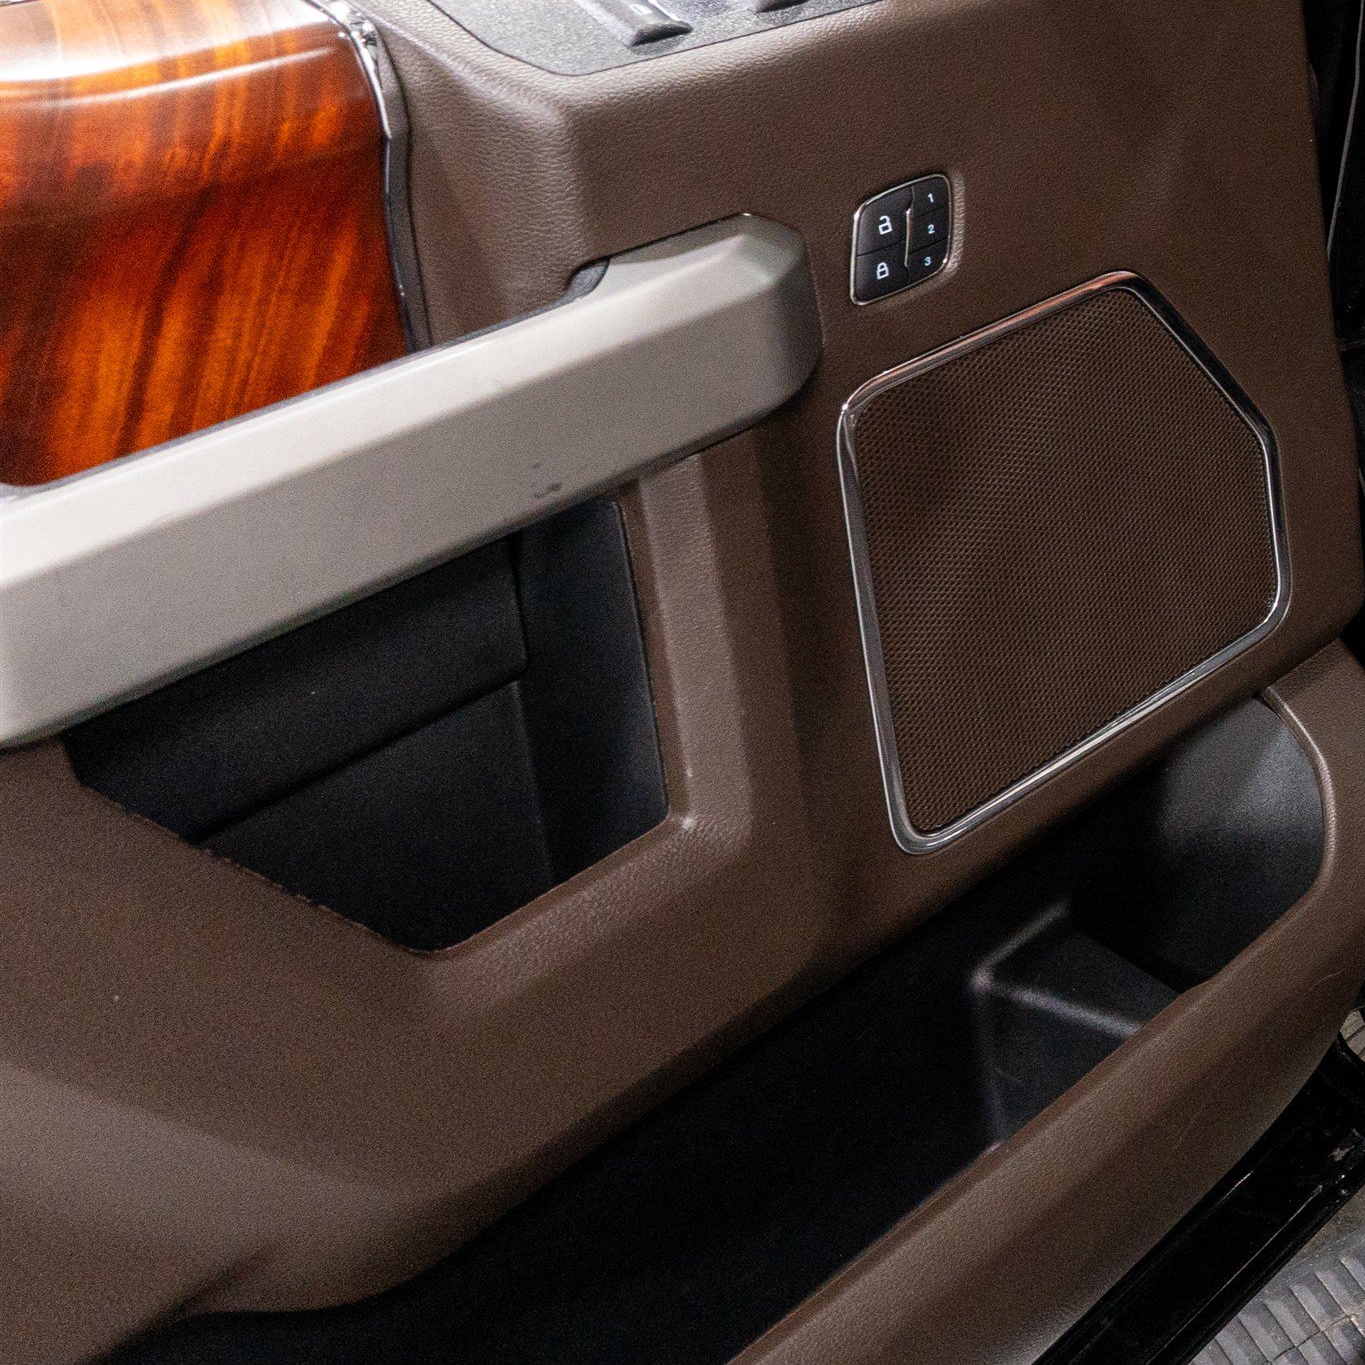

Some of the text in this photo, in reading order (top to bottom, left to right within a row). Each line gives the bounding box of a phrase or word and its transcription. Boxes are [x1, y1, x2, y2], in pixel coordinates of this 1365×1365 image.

[927, 192, 934, 203] 1
[927, 224, 935, 234] 2
[924, 256, 932, 266] 3
